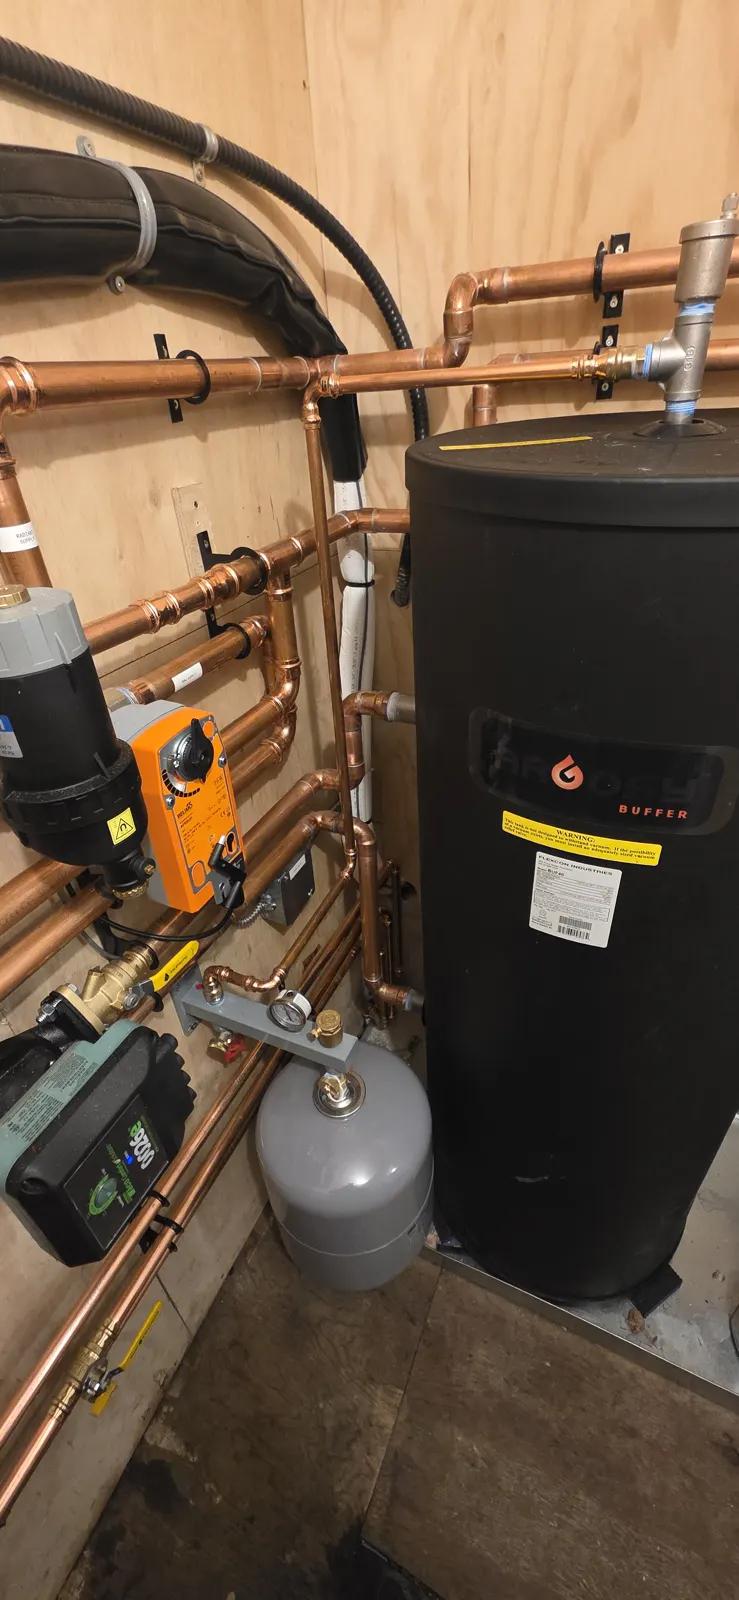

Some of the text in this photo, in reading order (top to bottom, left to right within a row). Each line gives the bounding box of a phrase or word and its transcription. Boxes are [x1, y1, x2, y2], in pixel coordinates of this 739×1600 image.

[619, 804, 688, 819] BUFFER
[538, 829, 558, 839] designed
[565, 837, 589, 846] withstand
[556, 829, 596, 843] WARNING:
[591, 847, 619, 856] adequately
[538, 855, 570, 867] FLEXCON
[570, 864, 613, 876] INDUSTRIES
